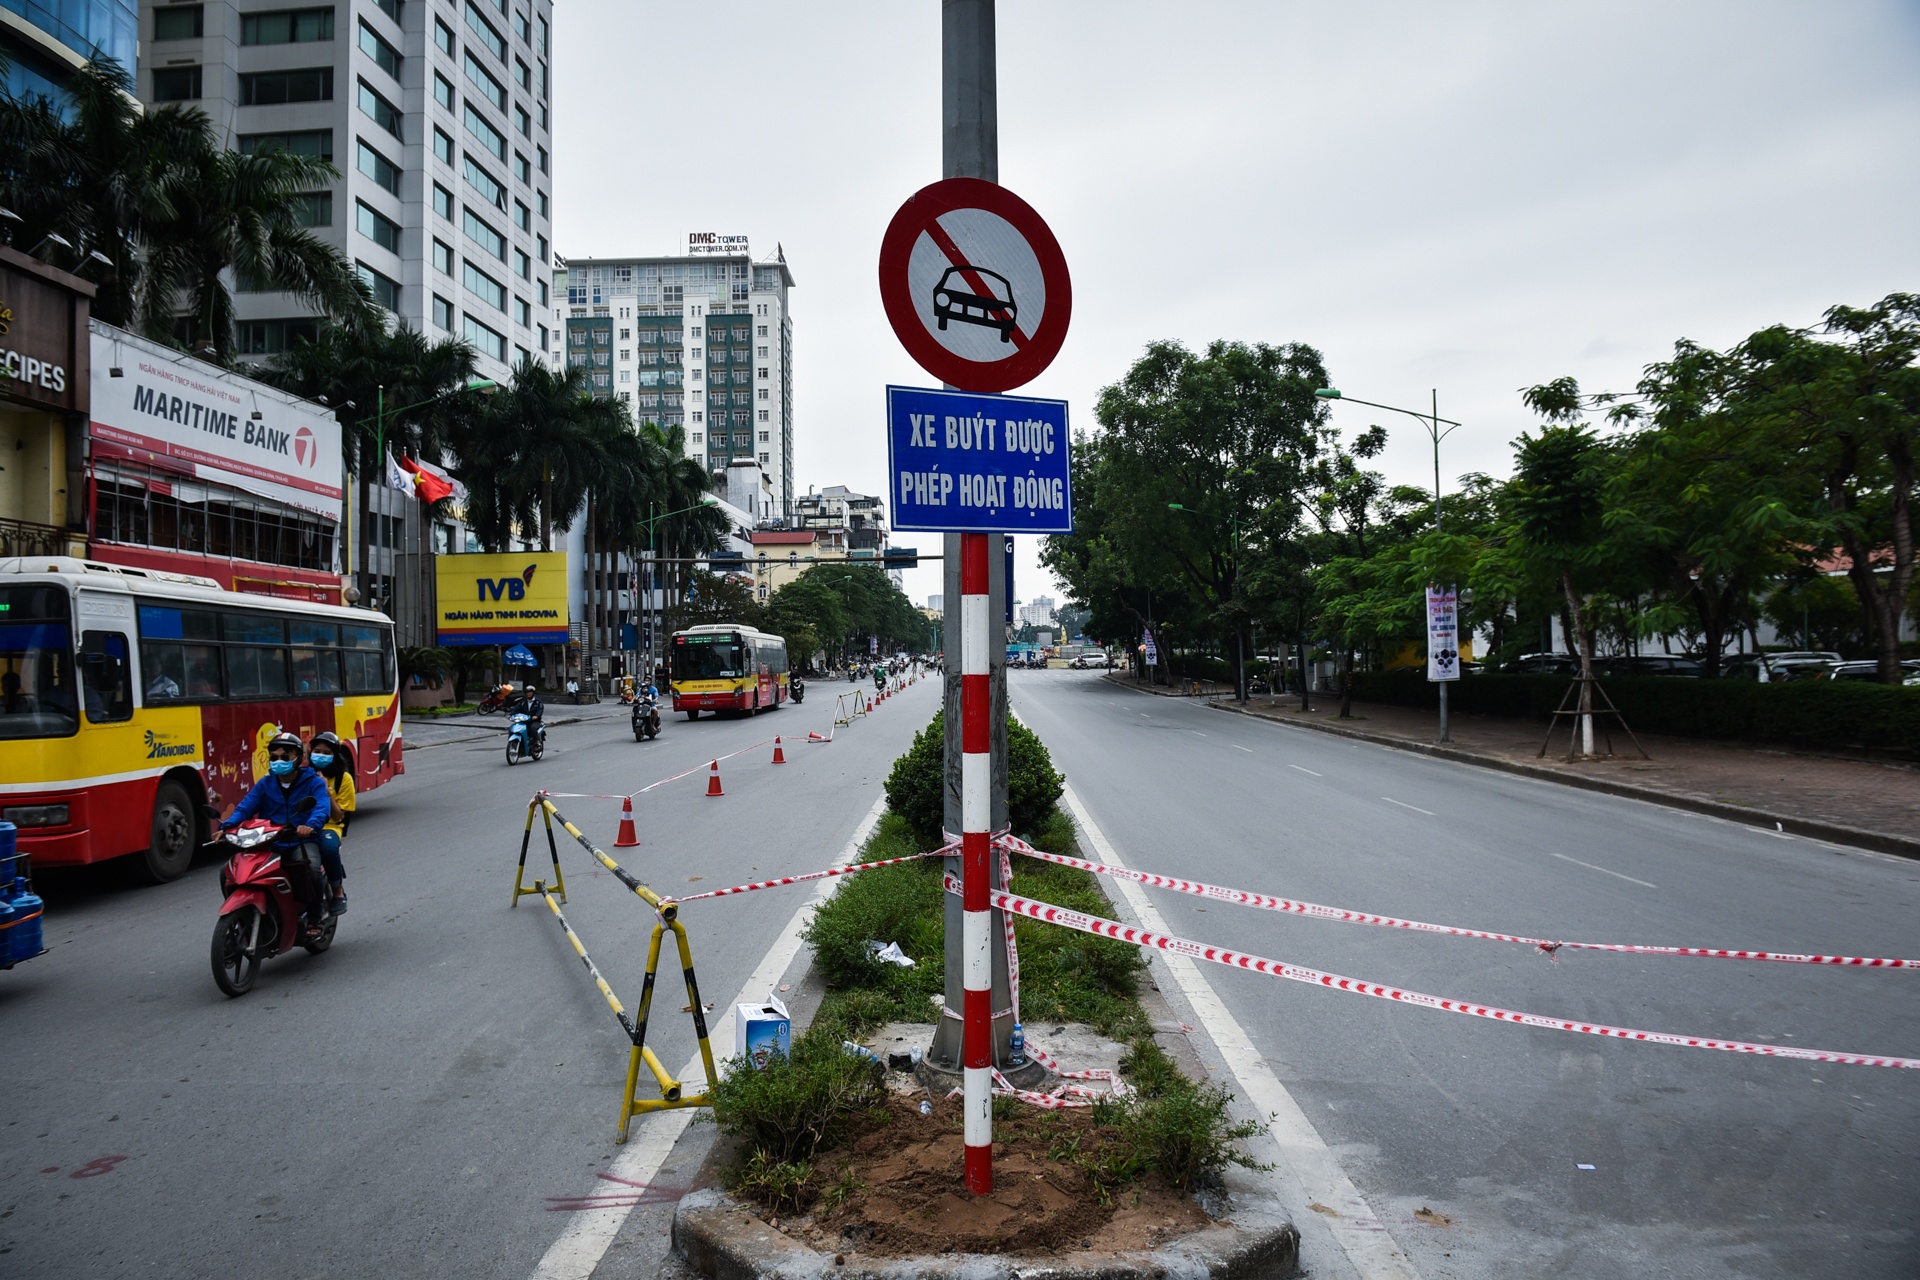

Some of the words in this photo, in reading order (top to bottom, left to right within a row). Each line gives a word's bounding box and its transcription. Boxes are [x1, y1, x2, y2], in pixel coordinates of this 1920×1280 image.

[688, 232, 716, 244] DMC
[0, 348, 65, 392] CIPES
[138, 362, 156, 376] NGÂN
[157, 370, 173, 381] HÀNG
[174, 376, 190, 386] TMCP
[190, 381, 206, 392] HÀNG
[216, 391, 227, 401] VIỆT
[228, 394, 240, 404] NAM
[132, 384, 238, 440] MARITIME
[244, 420, 290, 456] BANK
[910, 414, 936, 448] XE
[945, 412, 996, 450] BUÝT
[1005, 418, 1054, 462] ĐƯỢC
[900, 464, 954, 506] PHÉP
[959, 474, 1006, 516] HOẠT
[1014, 470, 1064, 516] ĐỘNG
[476, 578, 525, 601] IVB
[445, 610, 468, 620] NGÂN
[470, 610, 494, 620] HÀNG
[495, 611, 517, 619] TNHH
[520, 610, 558, 618] INDOVINA
[148, 742, 194, 758] HANOIBUS
